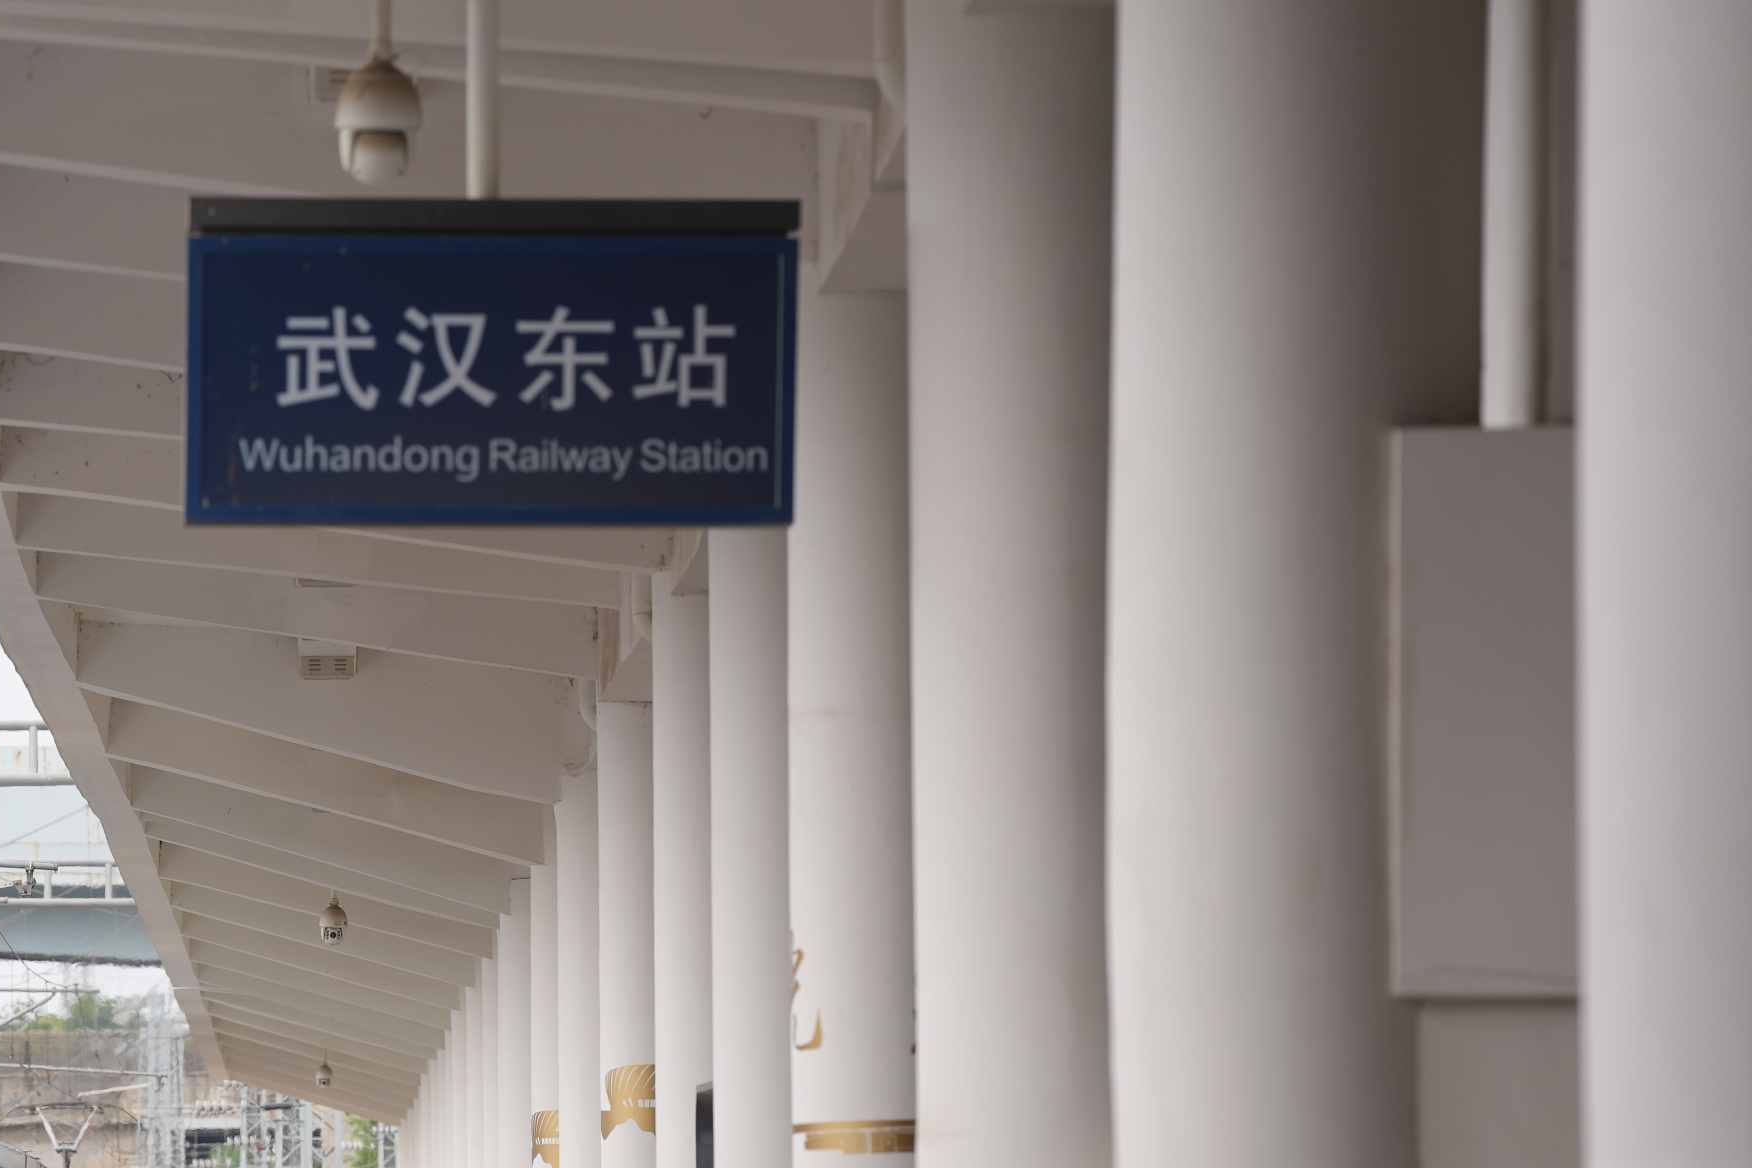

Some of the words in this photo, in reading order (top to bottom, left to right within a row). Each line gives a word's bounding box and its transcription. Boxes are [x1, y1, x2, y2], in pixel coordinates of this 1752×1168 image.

[276, 304, 737, 411] 武汉东站
[238, 434, 481, 483] Wuhandong
[487, 437, 633, 481] Railway
[639, 437, 769, 474] Station
